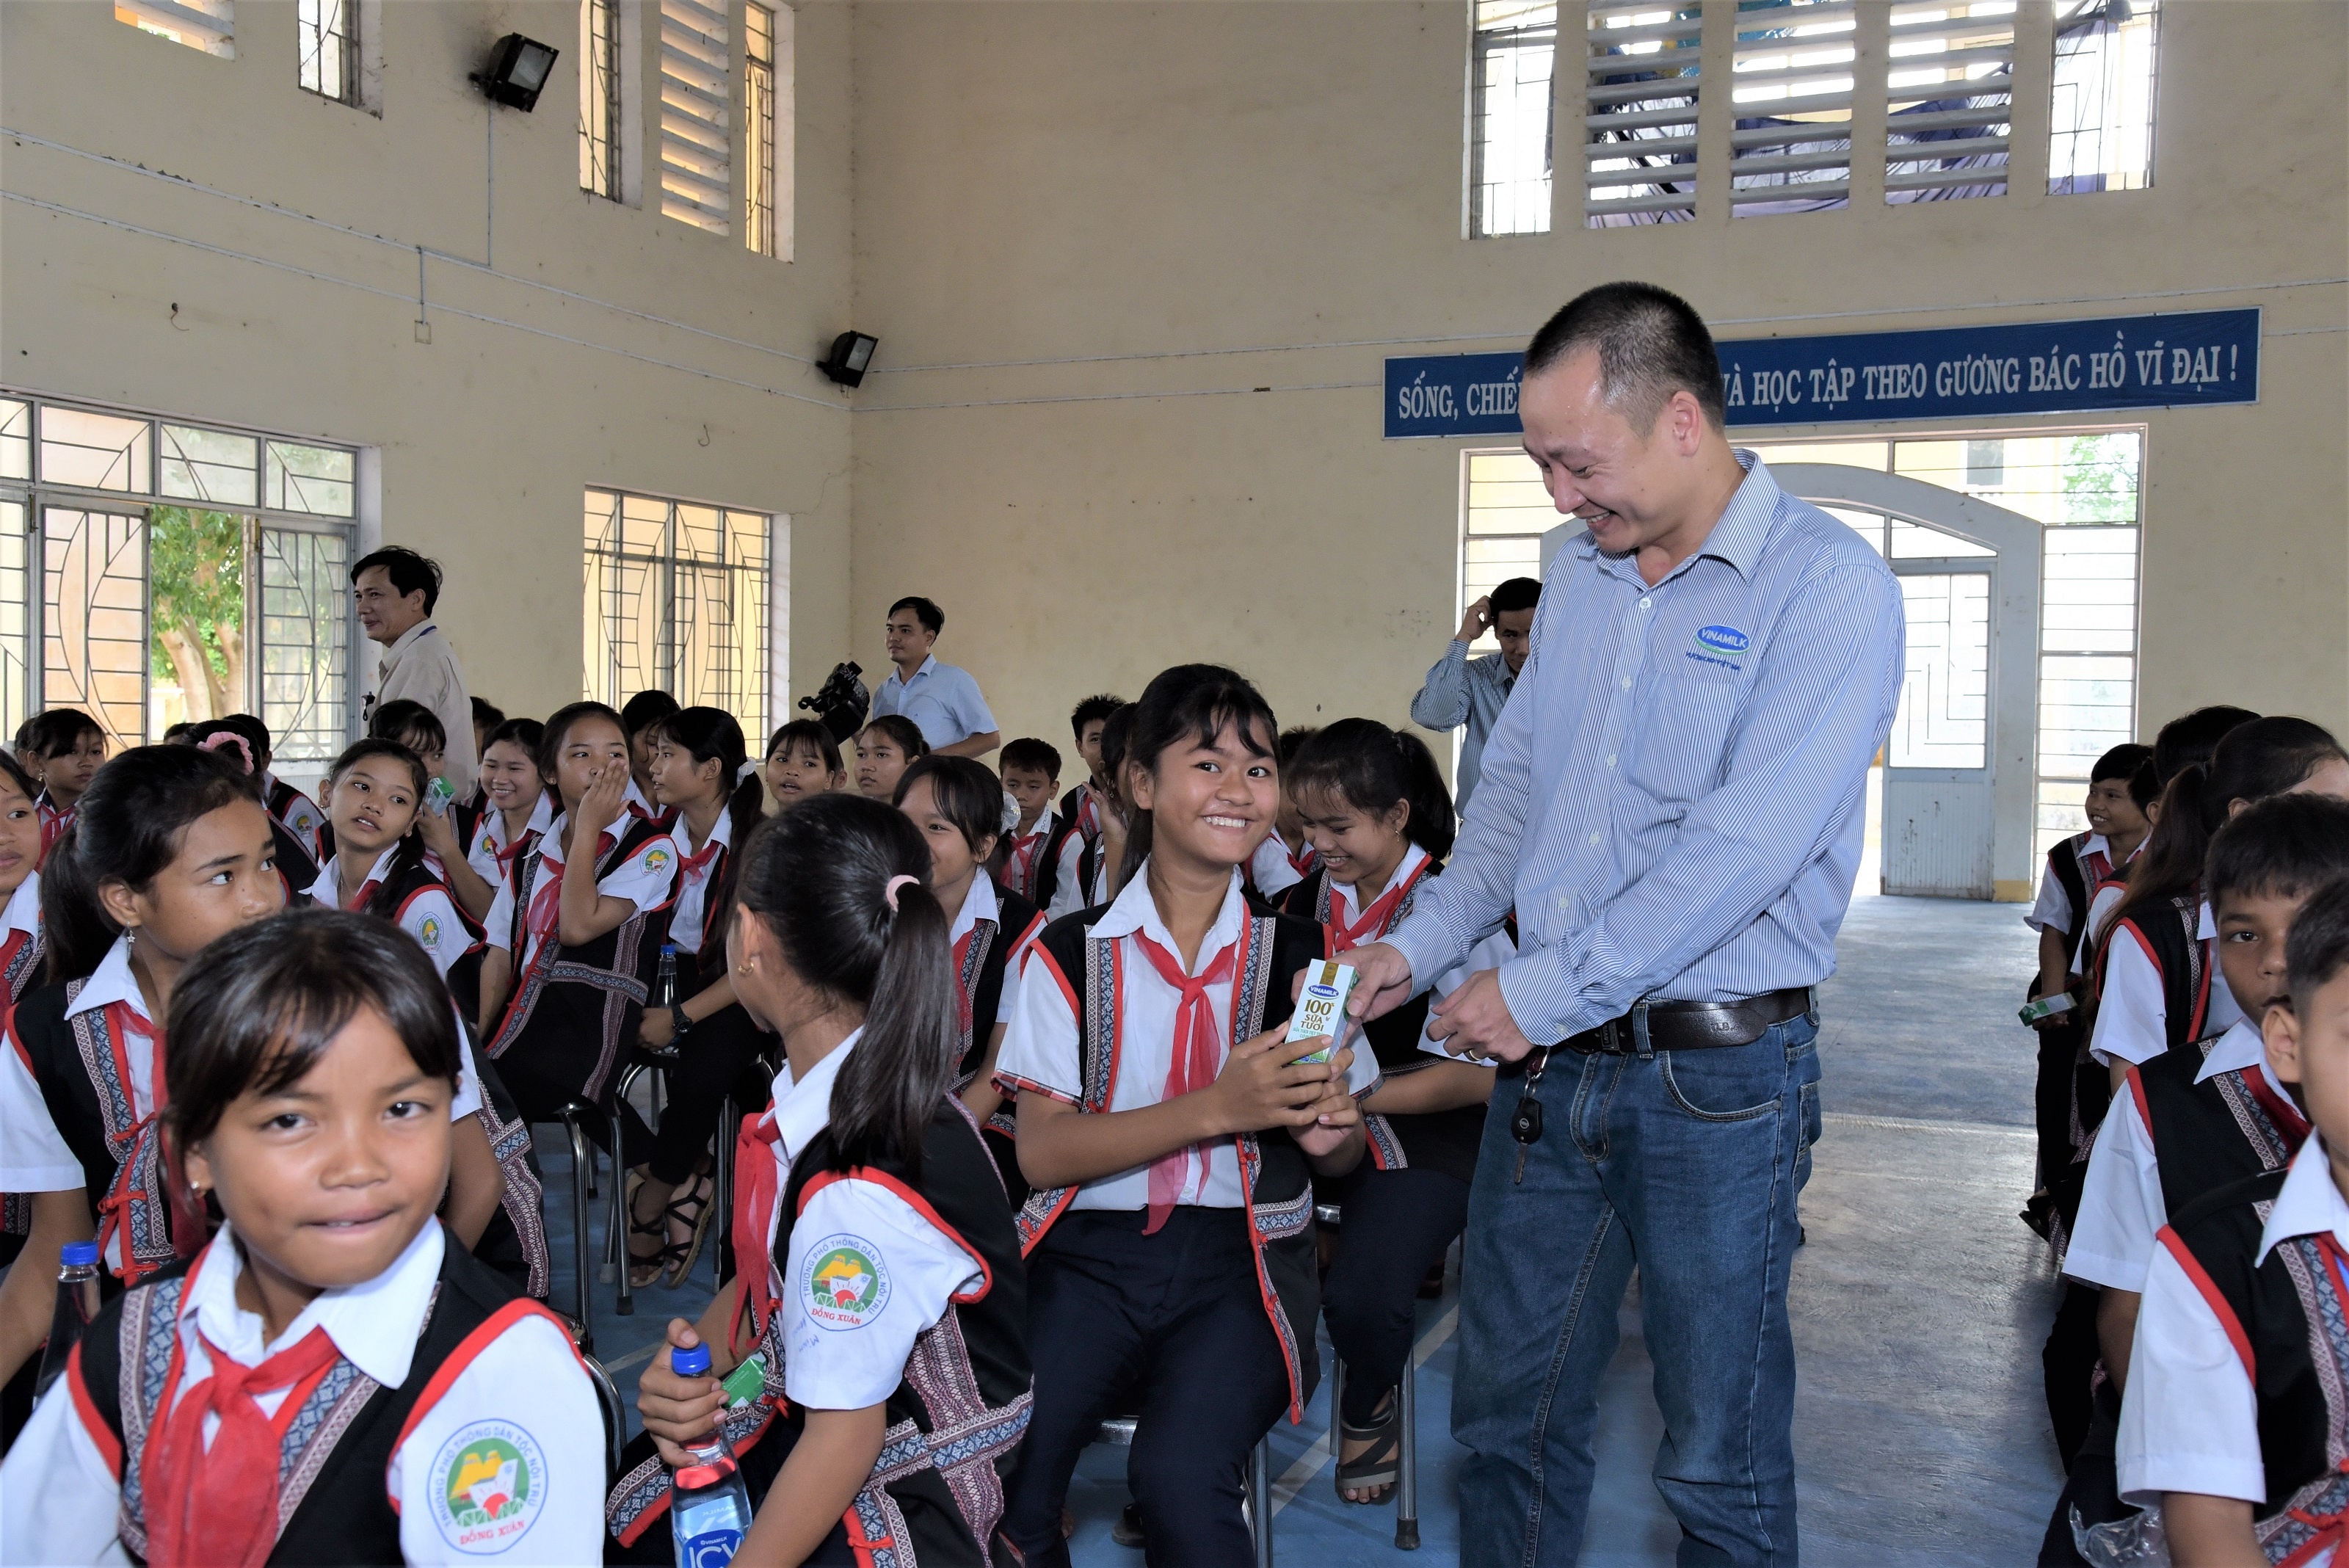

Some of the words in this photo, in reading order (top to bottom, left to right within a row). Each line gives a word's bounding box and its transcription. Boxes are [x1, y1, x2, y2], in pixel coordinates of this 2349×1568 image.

[1752, 370, 1801, 413] HỌC
[1809, 357, 1856, 410] TẬP
[1862, 363, 1928, 400] THEO
[1935, 353, 2021, 397] GƯƠNG
[2028, 344, 2081, 392] BÁC
[2088, 330, 2126, 388] HỒ
[2135, 340, 2164, 386] VĨ
[2171, 346, 2221, 392] ĐẠI
[1398, 370, 1459, 421] SỐNG,
[1467, 366, 1523, 416] CHIẾ
[1701, 628, 1747, 648] VINAMILK
[1310, 986, 1338, 996] VINAMILK
[1301, 1020, 1324, 1032] TƯƠI
[1304, 1013, 1323, 1024] SỮA
